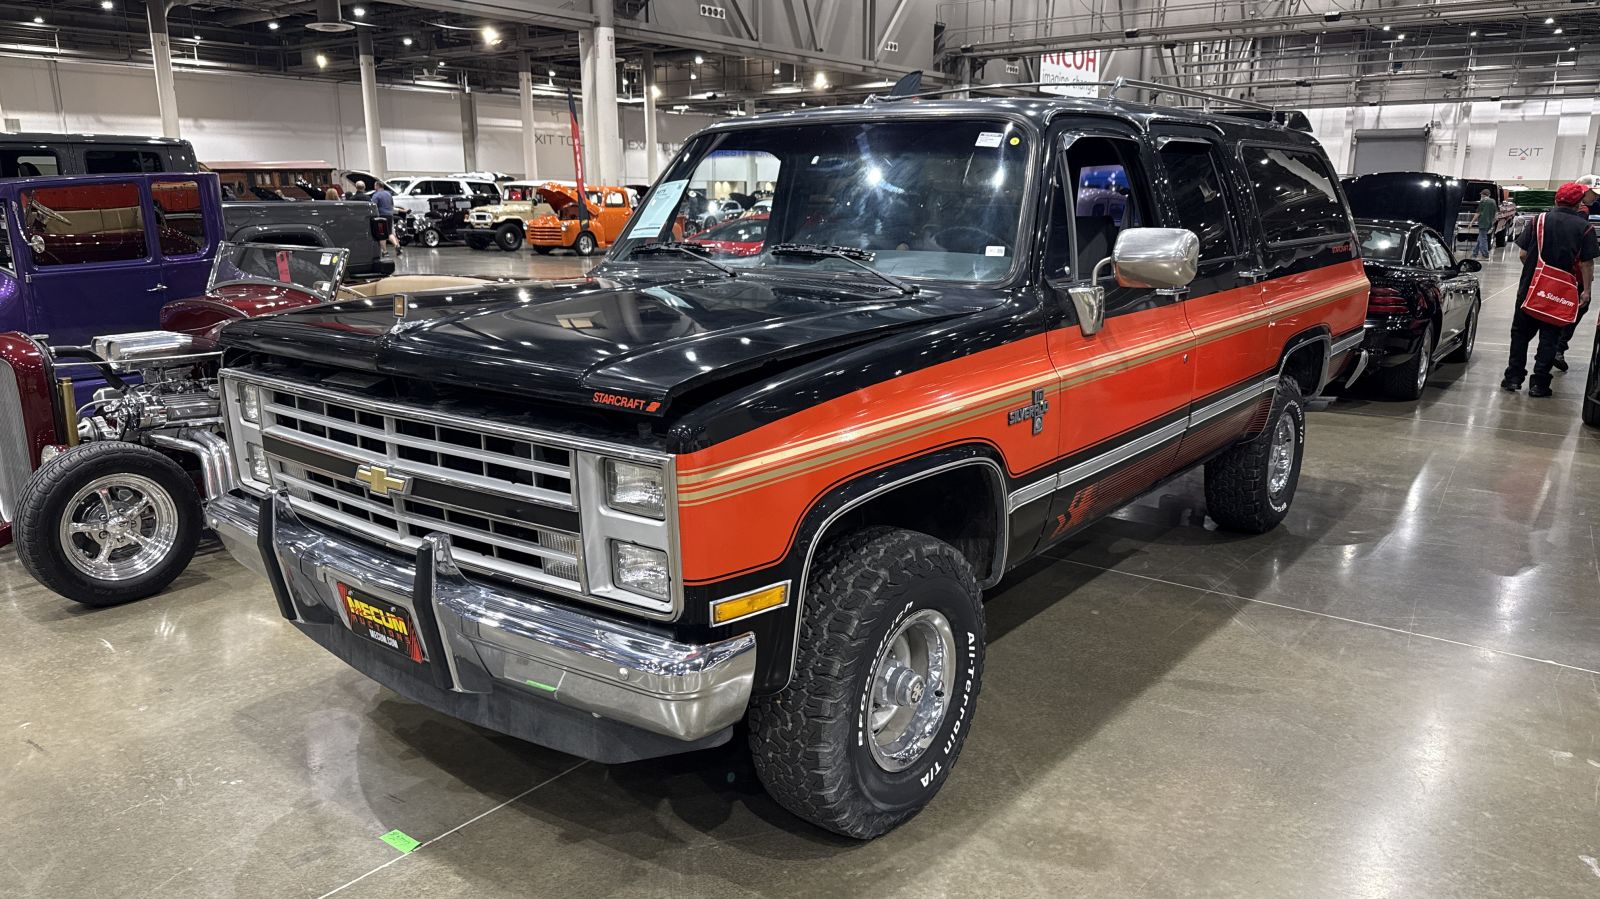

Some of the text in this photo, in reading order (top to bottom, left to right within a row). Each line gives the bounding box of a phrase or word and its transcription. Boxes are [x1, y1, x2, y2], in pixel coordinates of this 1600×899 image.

[534, 134, 555, 145] XIT
[1508, 147, 1544, 157] EXIT
[592, 391, 645, 411] STARCRAFT
[1008, 400, 1049, 426] SILVERADO
[346, 596, 409, 636] MECUM
[368, 628, 399, 649] MECUM.COM
[920, 631, 976, 788] All-Terrain T/A
